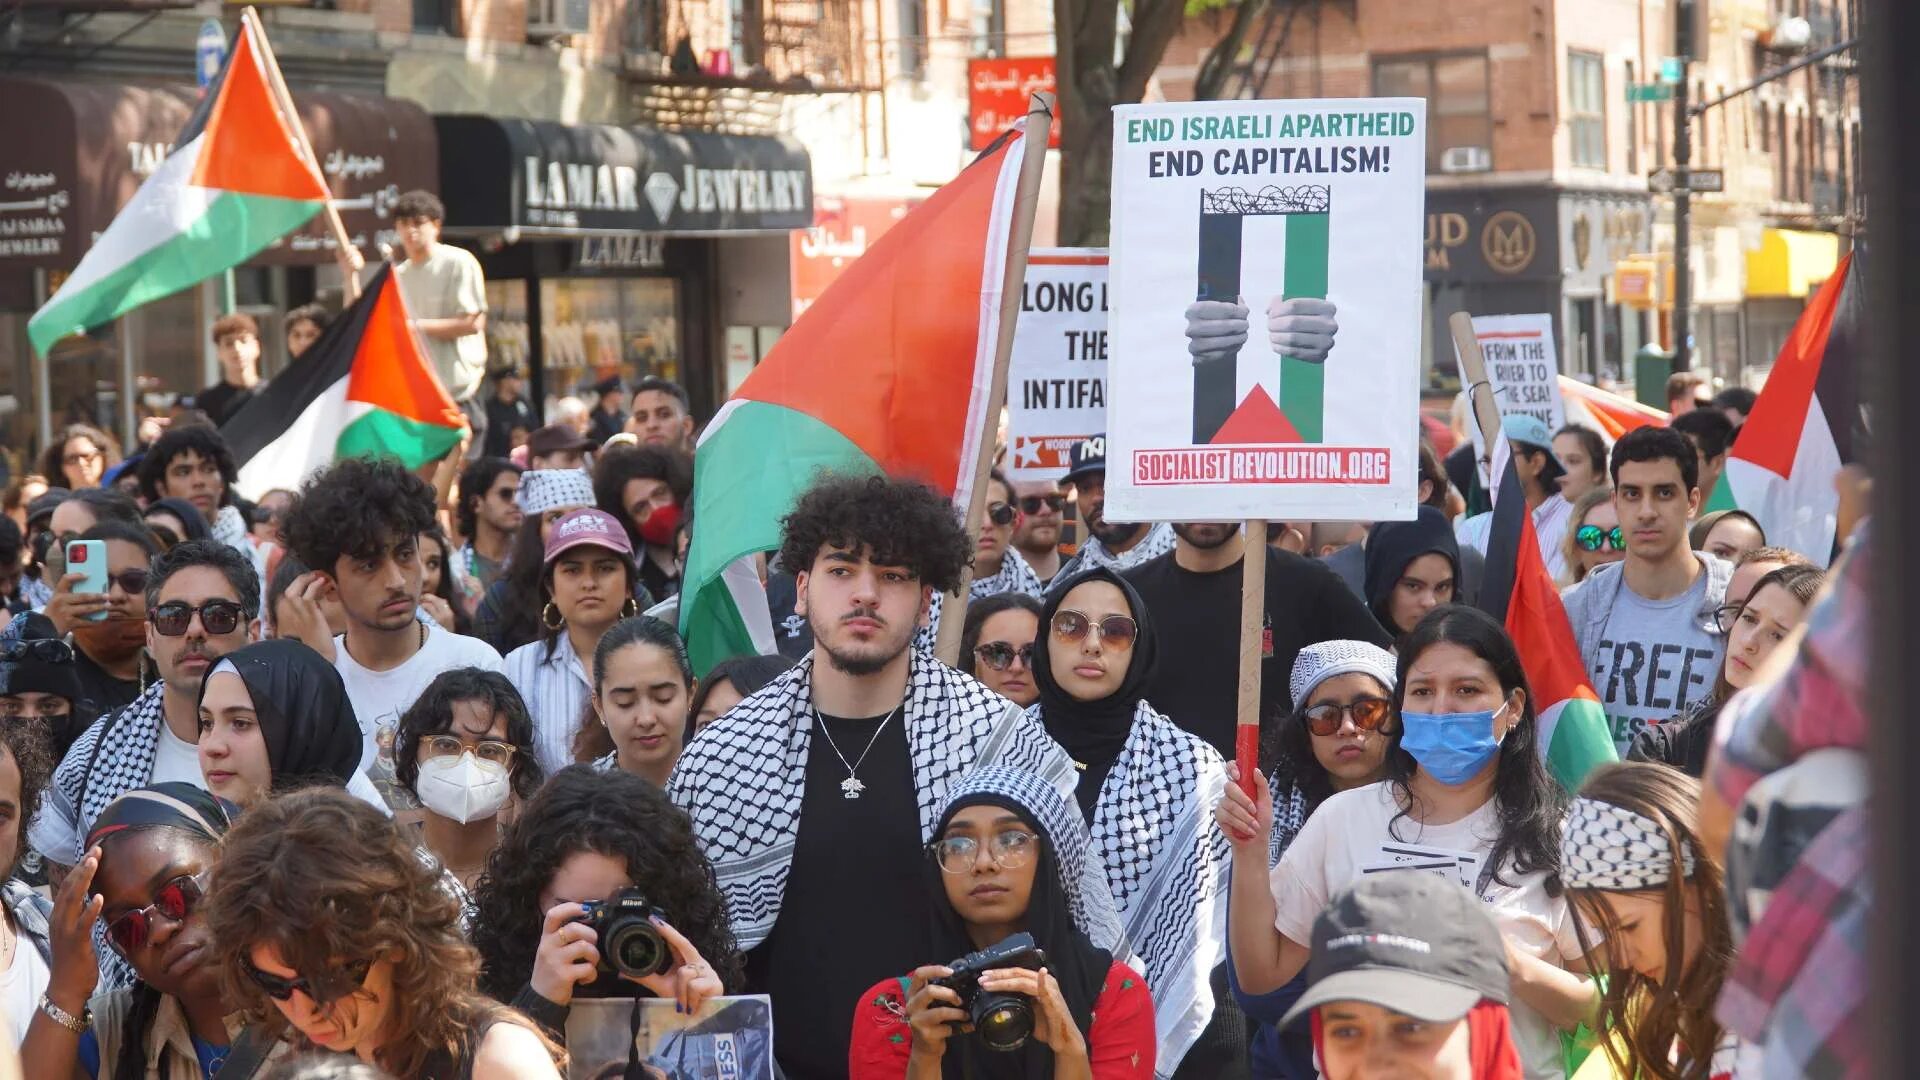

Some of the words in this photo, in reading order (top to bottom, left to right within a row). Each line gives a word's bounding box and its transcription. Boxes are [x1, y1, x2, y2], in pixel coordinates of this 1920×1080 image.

[1128, 118, 1174, 143] END
[1182, 115, 1272, 140] ISRAELI
[1280, 112, 1415, 138] APARTHEID
[1149, 151, 1203, 178] END
[1213, 146, 1390, 175] CAPITALISM!
[525, 156, 639, 209] LAMAR
[680, 164, 806, 213] JEWELRY
[1022, 281, 1094, 313] LONG
[1520, 342, 1545, 360] THE
[1529, 363, 1548, 382] TO
[1022, 379, 1107, 410] INTIFA
[1138, 453, 1226, 480] SOCIALIST
[1232, 451, 1387, 479] REVOLUTION.ORG
[1595, 640, 1714, 710] FREE
[621, 899, 643, 907] Nikon
[717, 1039, 737, 1080] ESS
